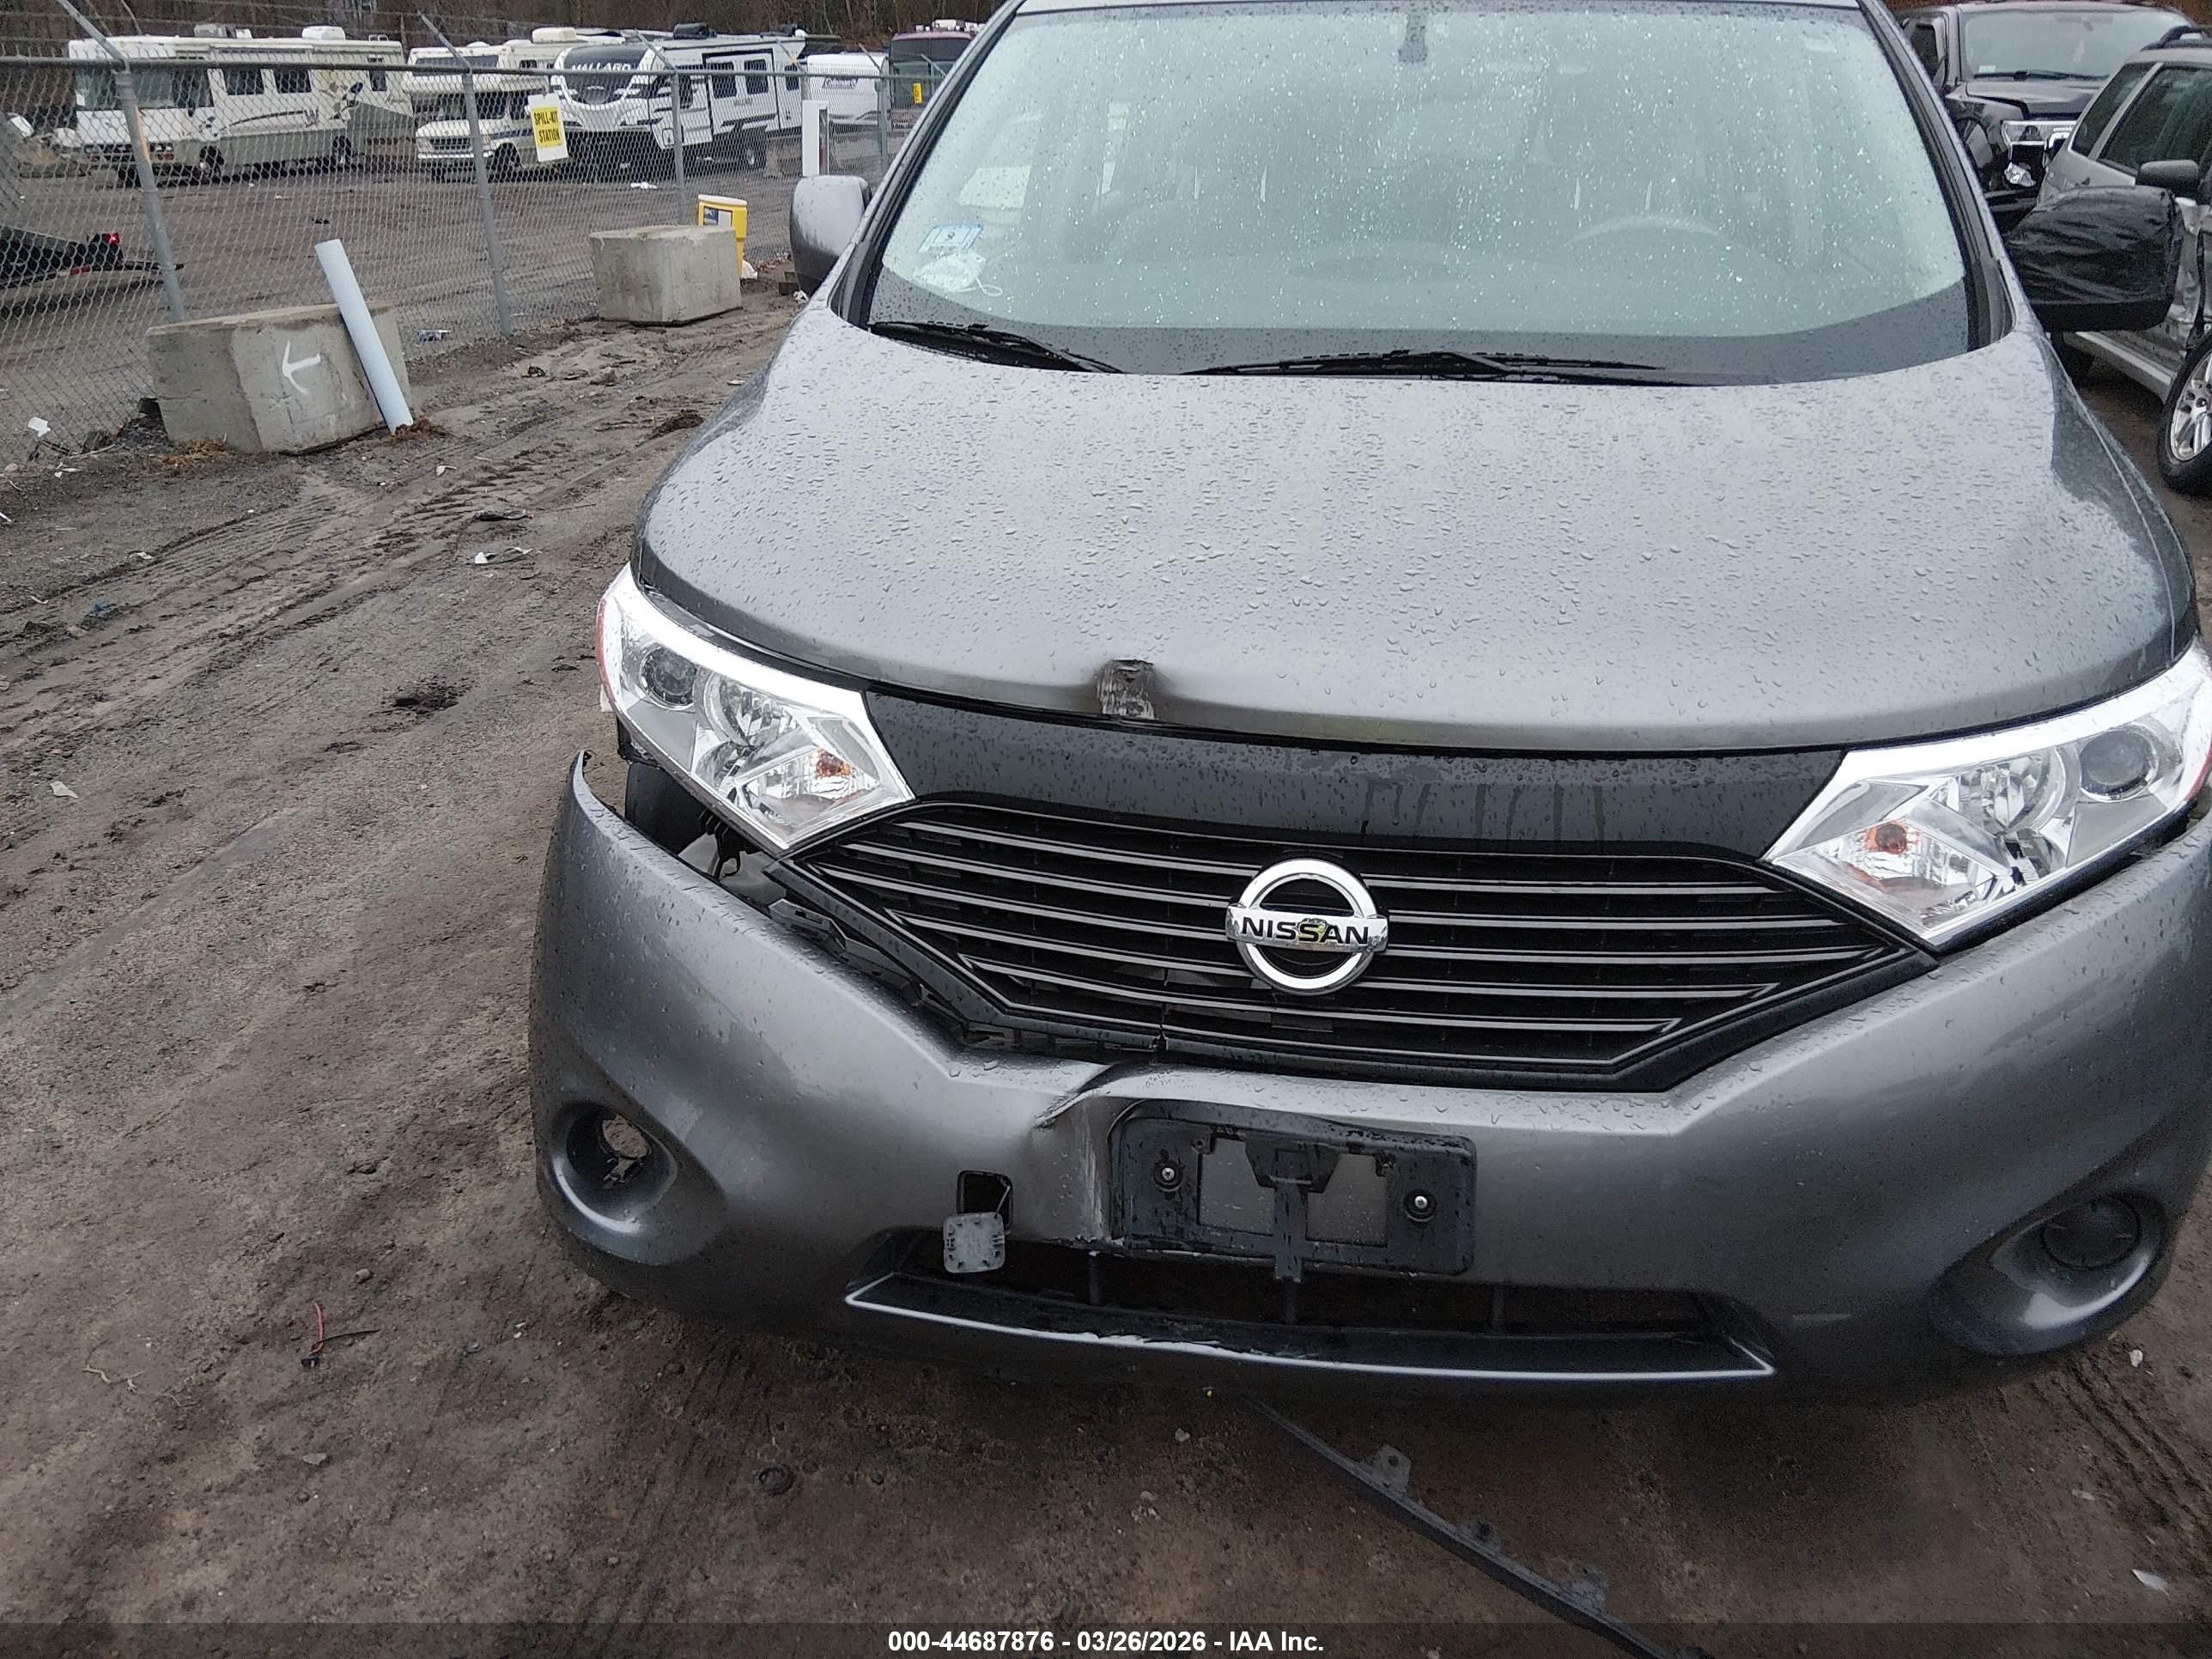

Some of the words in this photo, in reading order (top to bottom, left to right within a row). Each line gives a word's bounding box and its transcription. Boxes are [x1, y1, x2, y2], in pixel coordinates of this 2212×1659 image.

[533, 110, 559, 125] SPILL-KIT
[538, 128, 560, 143] STATION
[1242, 916, 1369, 945] NISSAN
